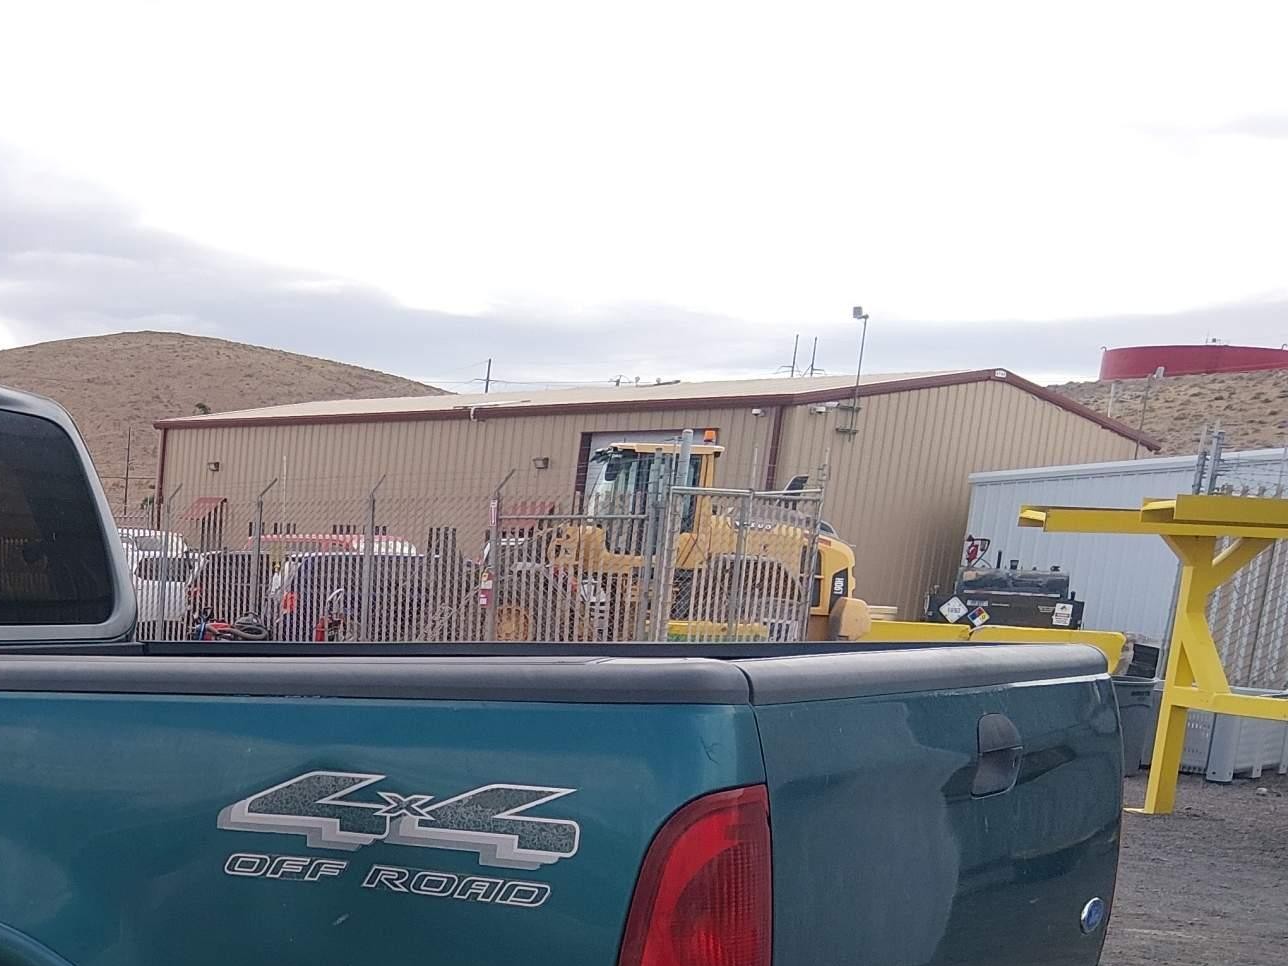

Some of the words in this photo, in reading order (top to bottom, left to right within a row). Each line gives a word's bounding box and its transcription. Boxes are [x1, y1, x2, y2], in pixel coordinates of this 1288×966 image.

[833, 577, 845, 595] L90H
[224, 852, 347, 881] OFF
[362, 864, 552, 908] ROAD
